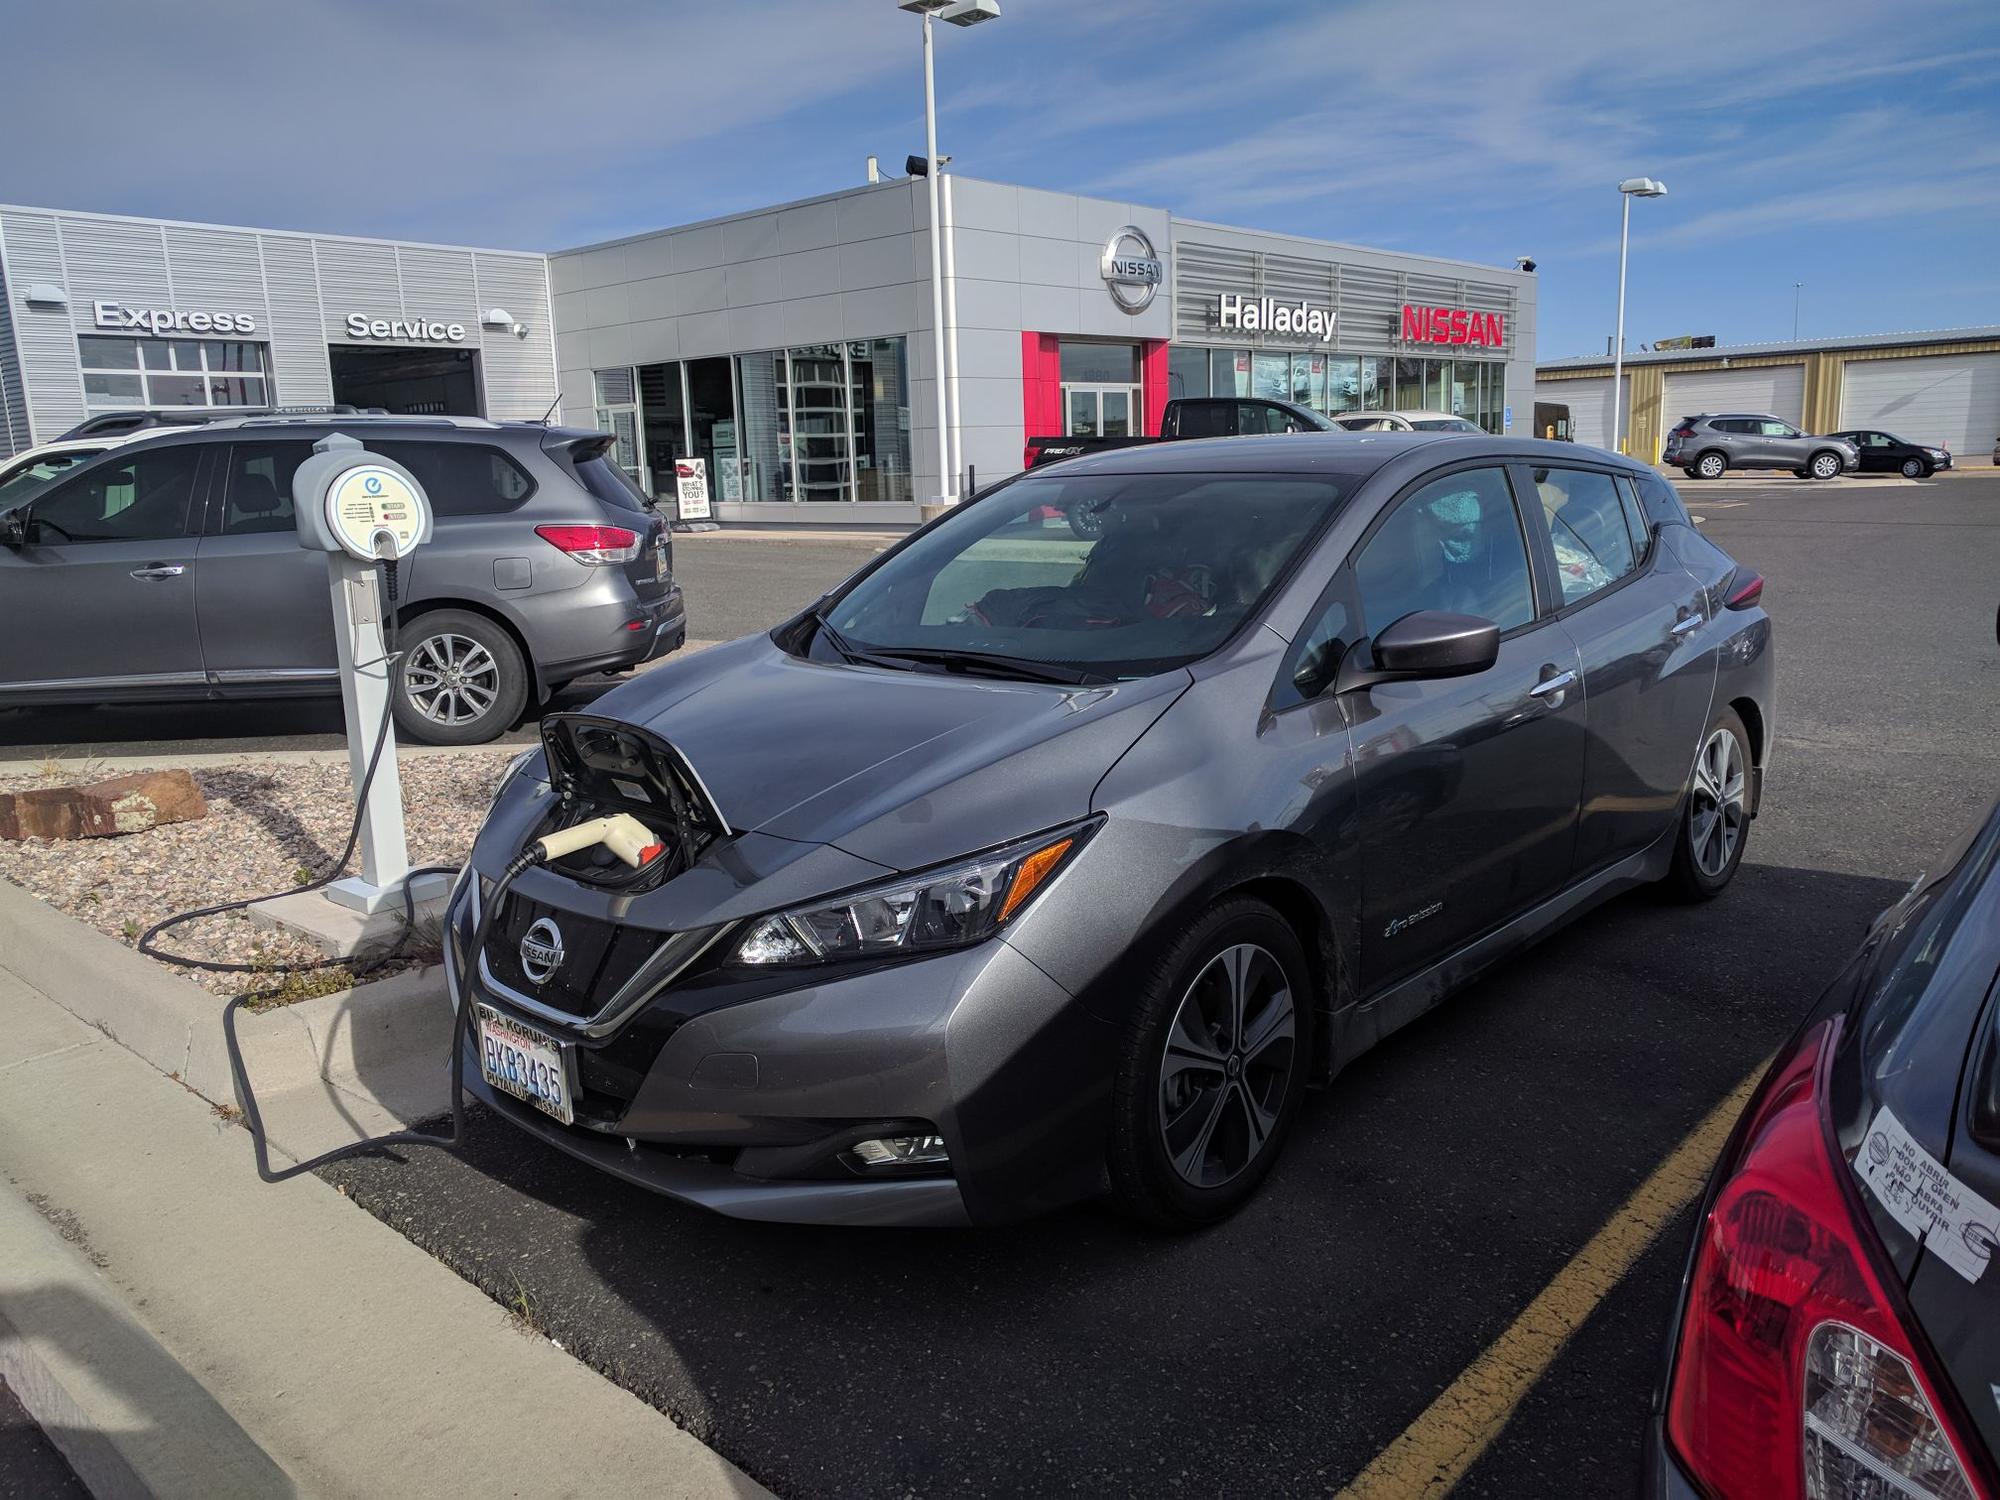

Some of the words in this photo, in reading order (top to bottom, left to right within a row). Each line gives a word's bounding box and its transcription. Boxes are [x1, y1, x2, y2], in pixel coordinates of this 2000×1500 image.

[1111, 260, 1160, 278] NISSAN
[93, 299, 257, 336] Express
[346, 312, 466, 343] Service
[1219, 293, 1336, 342] Halladay
[1401, 304, 1504, 347] NISSAN
[683, 491, 704, 499] YOU?
[480, 1007, 504, 1027] BILL
[485, 1021, 532, 1051] WASHINGTON
[485, 1036, 562, 1106] BKB3435
[1903, 1141, 1916, 1157] NO
[1920, 1160, 1950, 1189] ABRIR
[1931, 1183, 1960, 1210] OPEN
[1911, 1197, 1950, 1231] OUVRIR
